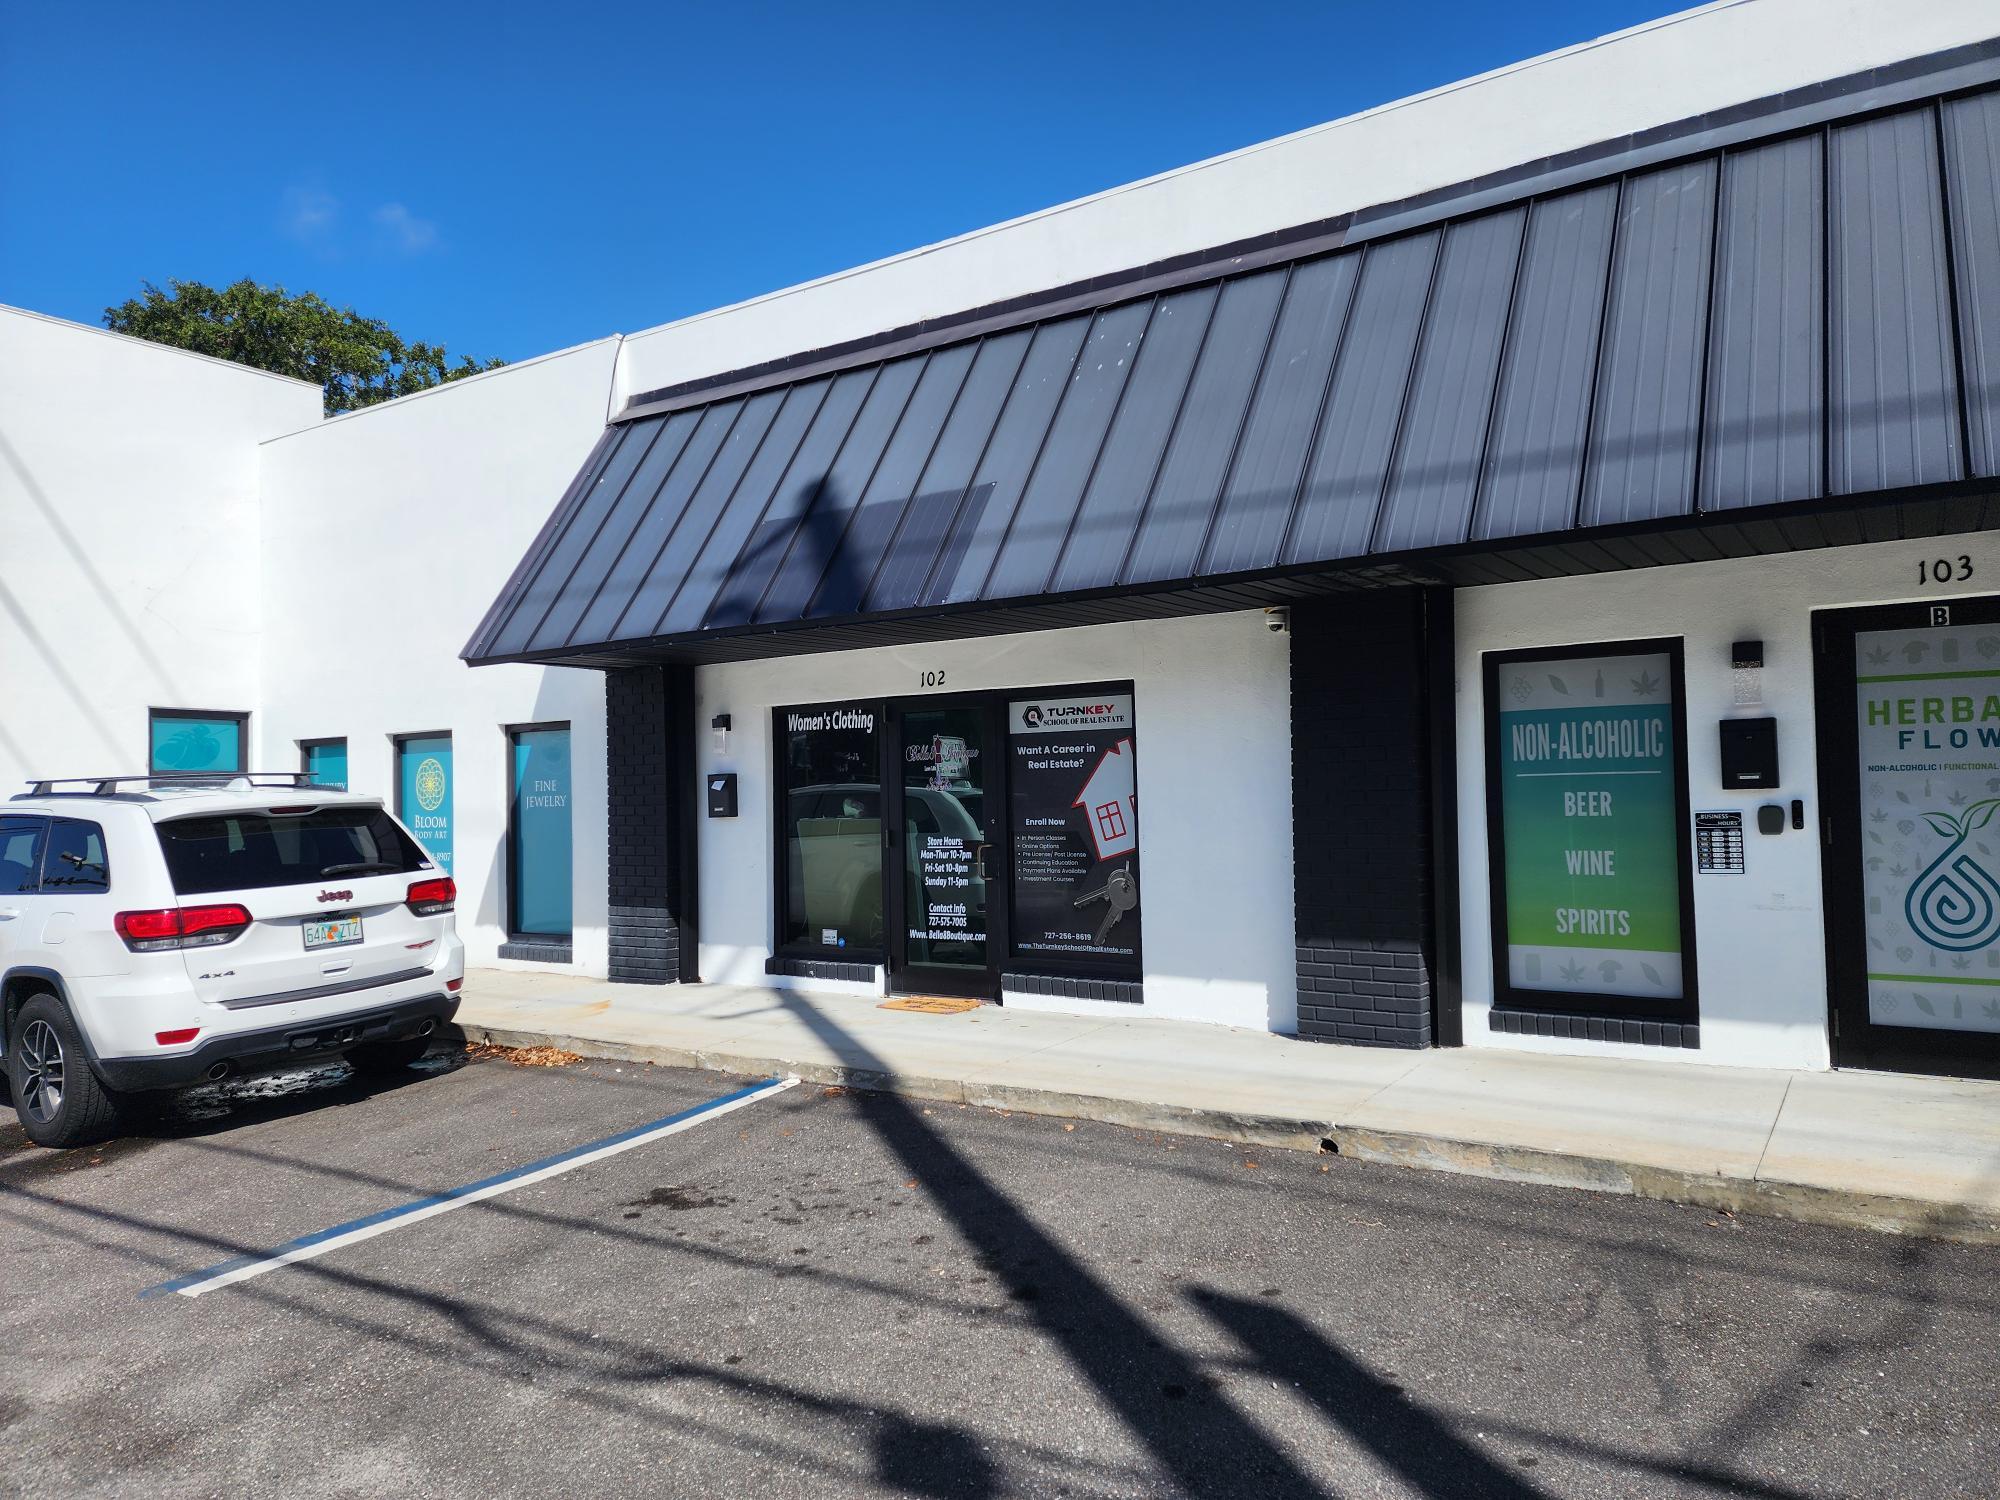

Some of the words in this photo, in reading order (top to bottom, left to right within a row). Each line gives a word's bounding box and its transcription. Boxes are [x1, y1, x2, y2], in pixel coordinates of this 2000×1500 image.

[1919, 555, 1973, 585] 103
[1933, 607, 1948, 626] B
[920, 670, 945, 687] 102
[1047, 704, 1115, 717] TURNKEY
[1868, 695, 2000, 726] HERBA
[788, 712, 831, 731] Women's
[832, 709, 874, 733] Clothing
[1043, 718, 1070, 726] SCHOOL
[1080, 716, 1097, 724] REAL
[1099, 715, 1124, 723] ESTATE
[1512, 718, 1664, 762] NON-ALCOHOLIC
[1898, 728, 2000, 750] FLOW
[1017, 745, 1042, 755] Want
[1044, 746, 1050, 754] A
[1052, 744, 1085, 754] Career
[1086, 743, 1096, 753] in
[1028, 760, 1048, 769] Real
[1050, 759, 1085, 769] Estate?
[1868, 763, 1937, 772] NON-ALCOHOLIC
[1944, 762, 1999, 771] FUNCTIONAL
[535, 779, 557, 792] FINE
[526, 795, 567, 810] JEWELRY
[1564, 791, 1613, 817] BEER
[1025, 818, 1047, 826] Enroll
[1048, 818, 1066, 826] Now
[927, 836, 942, 846] Store
[943, 836, 963, 846] Hours:
[920, 849, 949, 859] Mon-Thur
[950, 850, 972, 861] 10-7pm
[925, 863, 944, 873] Fri-Sat
[945, 863, 969, 874] 10-8pm
[1564, 850, 1615, 876] WINE
[1022, 867, 1046, 875] Payment
[925, 876, 947, 888] Sunday
[947, 877, 969, 888] 11-5pm
[316, 889, 354, 903] Jeep
[928, 903, 953, 913] Contact
[953, 903, 967, 914] Info
[928, 916, 967, 927] 727-575-7005
[1555, 908, 1631, 936] SPIRITS
[1044, 932, 1092, 941] 727-256-8619
